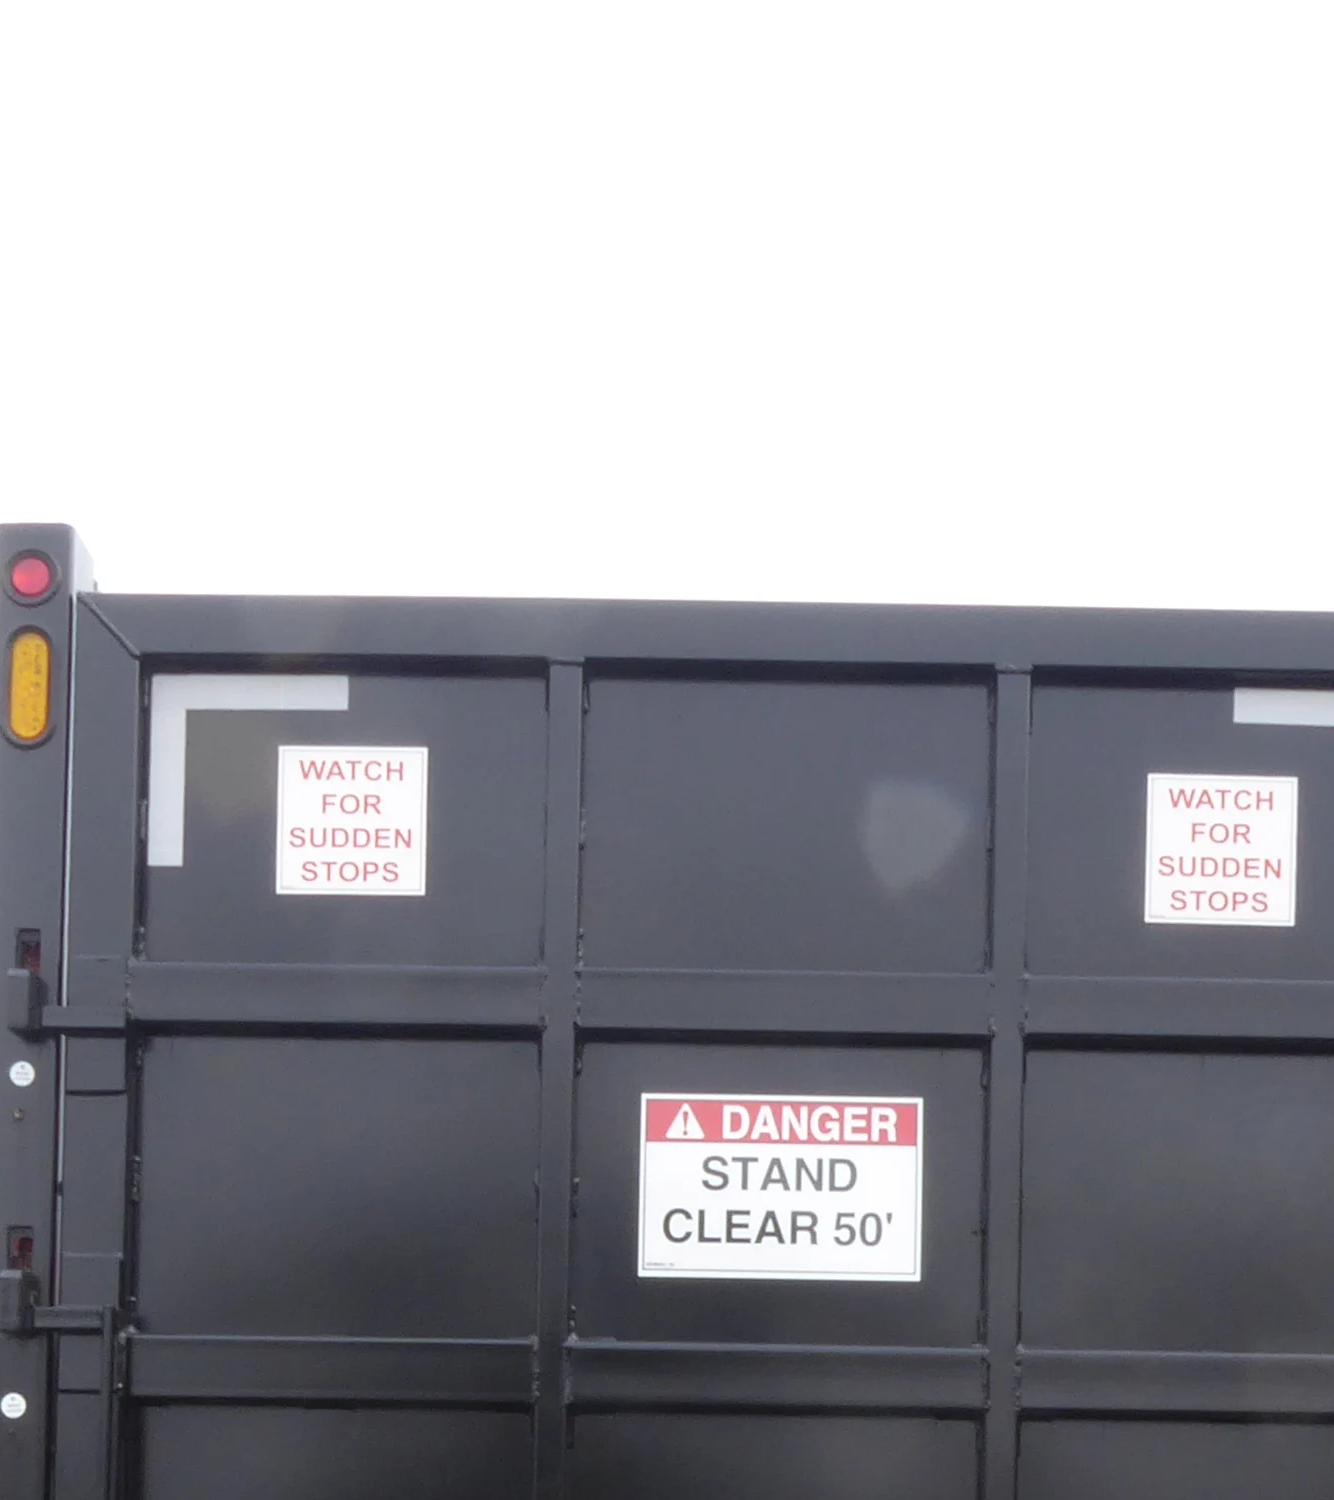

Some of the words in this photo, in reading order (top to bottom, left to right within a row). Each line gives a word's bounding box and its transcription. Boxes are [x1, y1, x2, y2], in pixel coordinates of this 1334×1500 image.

[299, 760, 404, 781] WATCH
[322, 794, 381, 815] FOR
[1168, 788, 1274, 811] WATCH
[289, 827, 412, 849] SUDDEN
[1191, 822, 1251, 844] FOR
[301, 861, 399, 882] STOPS
[1158, 855, 1282, 879] SUDDEN
[1170, 889, 1269, 913] STOPS
[721, 1104, 898, 1143] DANGER
[701, 1155, 858, 1192] STAND
[662, 1208, 818, 1245] CLEAR
[833, 1212, 893, 1247] 50'
